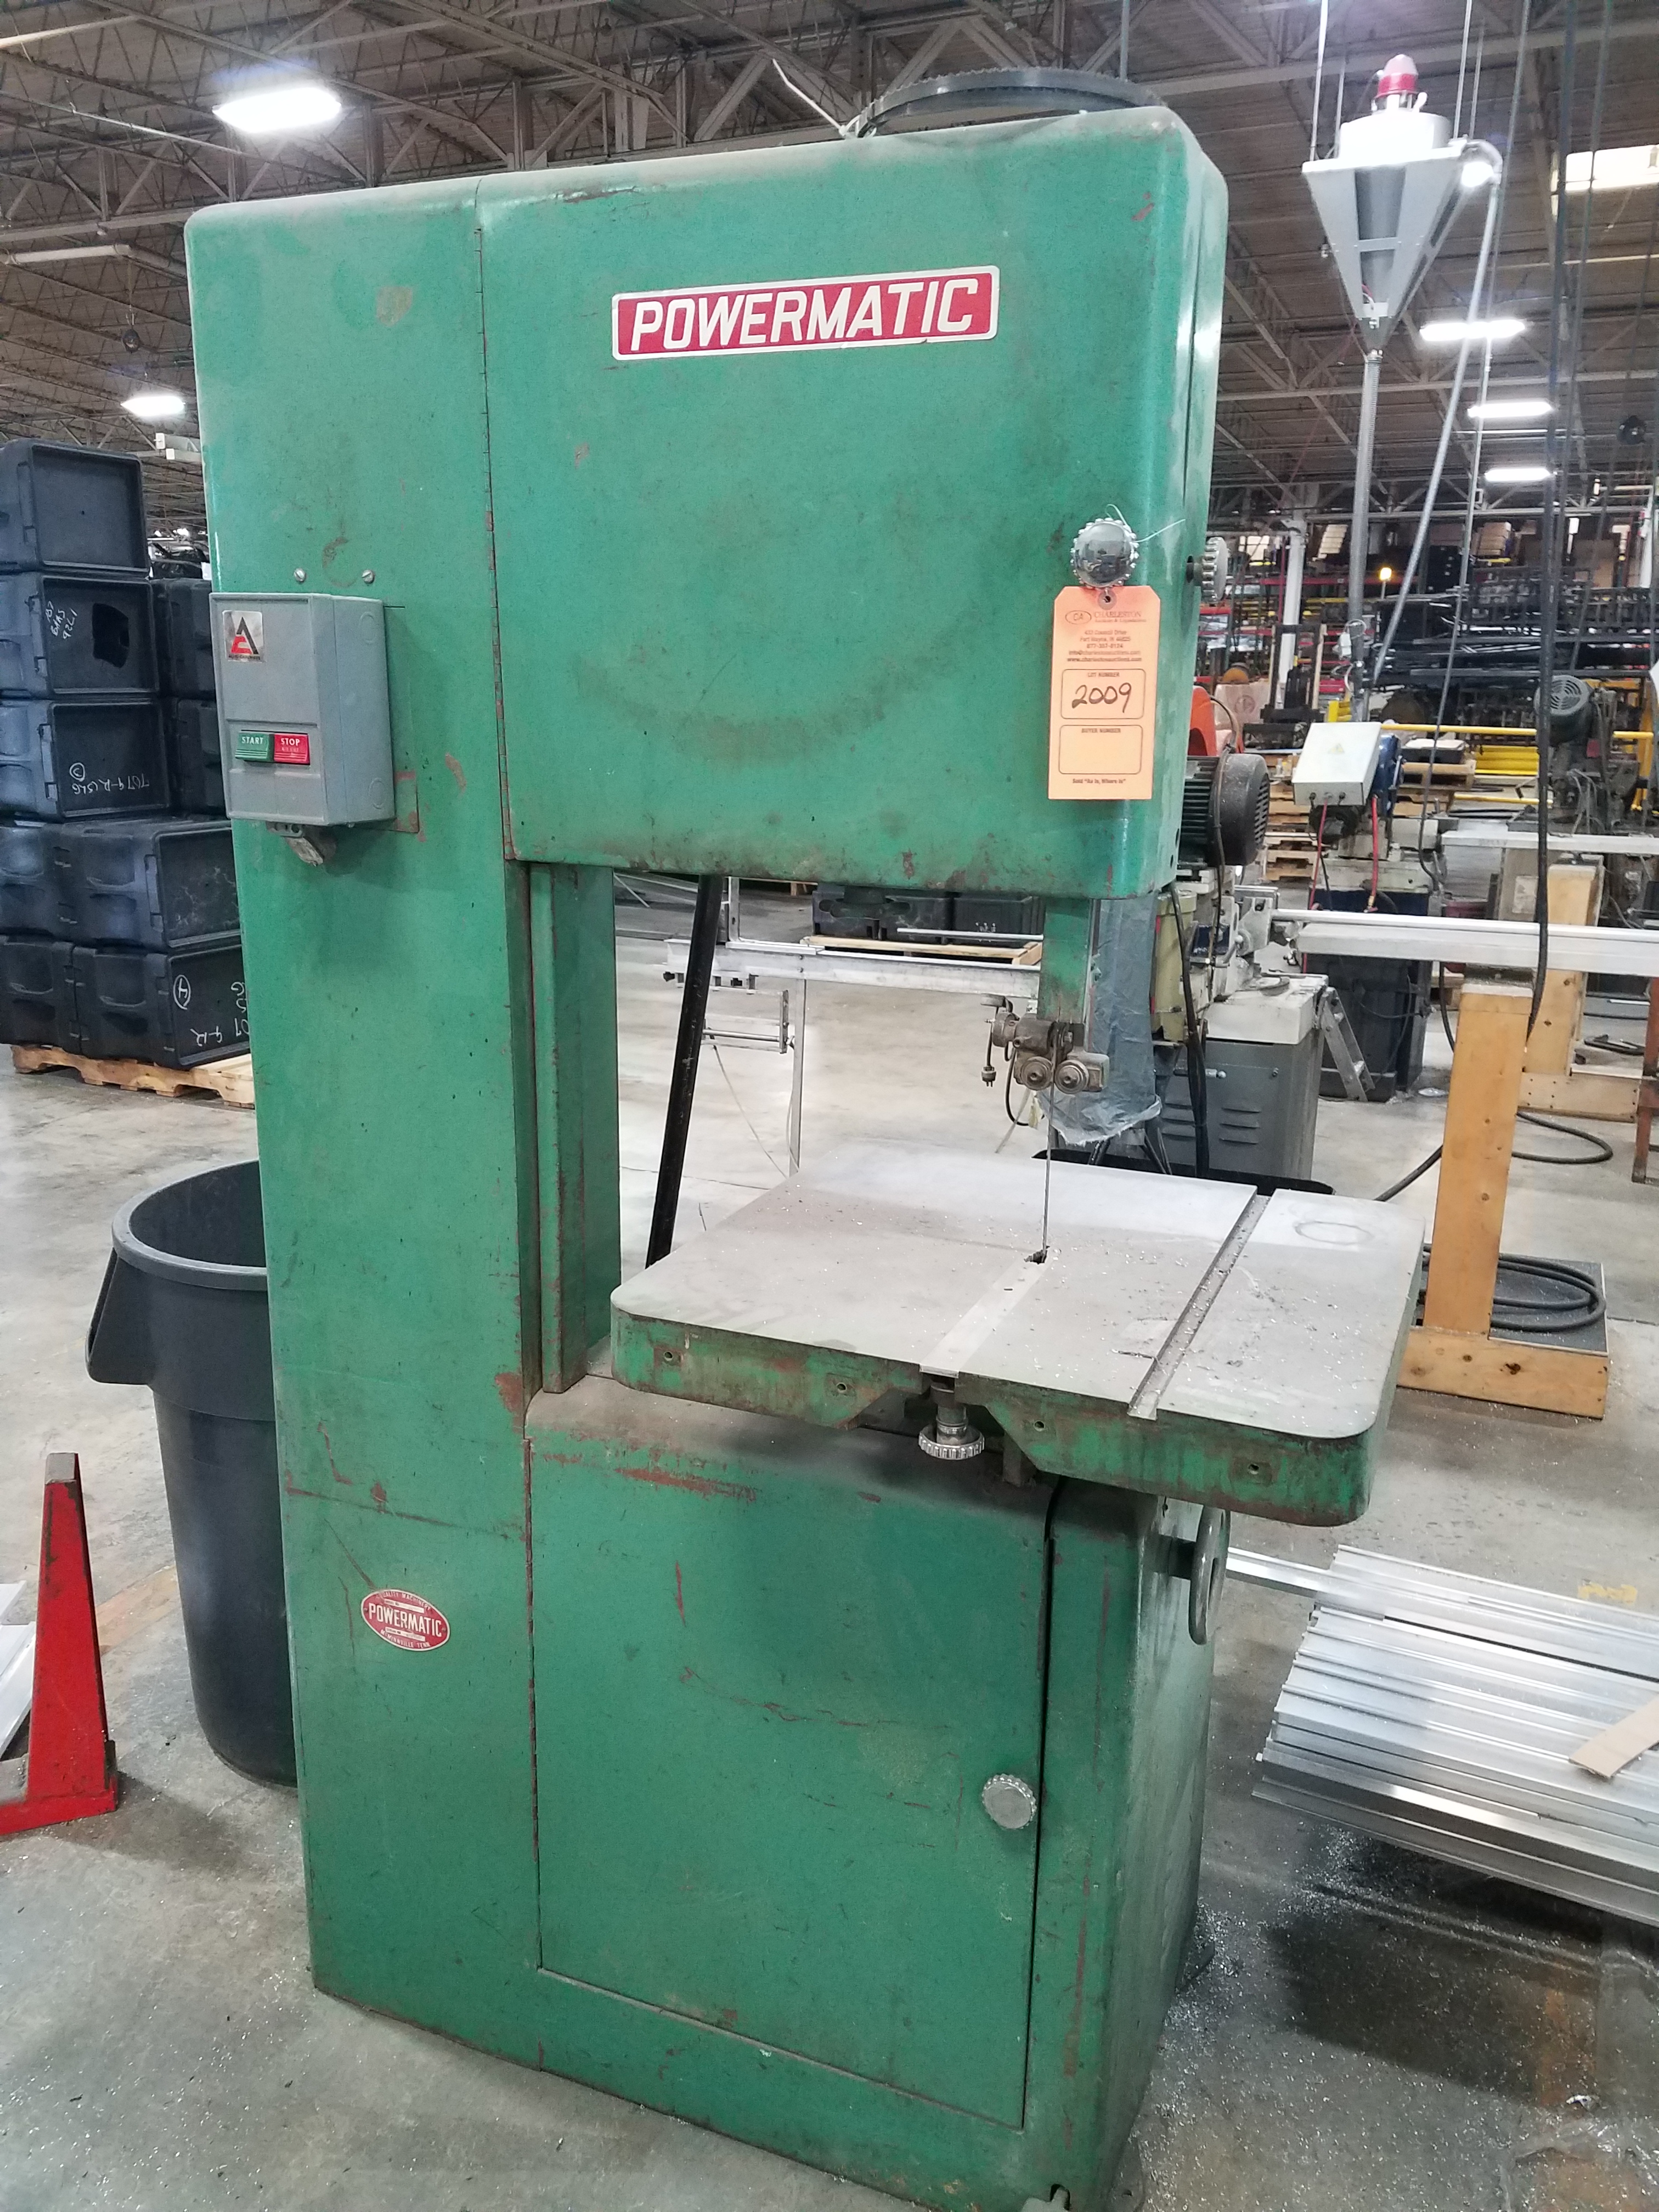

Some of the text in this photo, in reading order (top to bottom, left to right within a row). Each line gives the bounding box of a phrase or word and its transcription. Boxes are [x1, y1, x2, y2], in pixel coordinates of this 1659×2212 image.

[630, 278, 979, 351] POWERMATIC
[1072, 682, 1132, 713] 2009
[241, 736, 263, 744] START
[281, 737, 300, 747] STOP
[402, 1592, 431, 1611] MACHINERY
[368, 1602, 442, 1637] POWERMATIC
